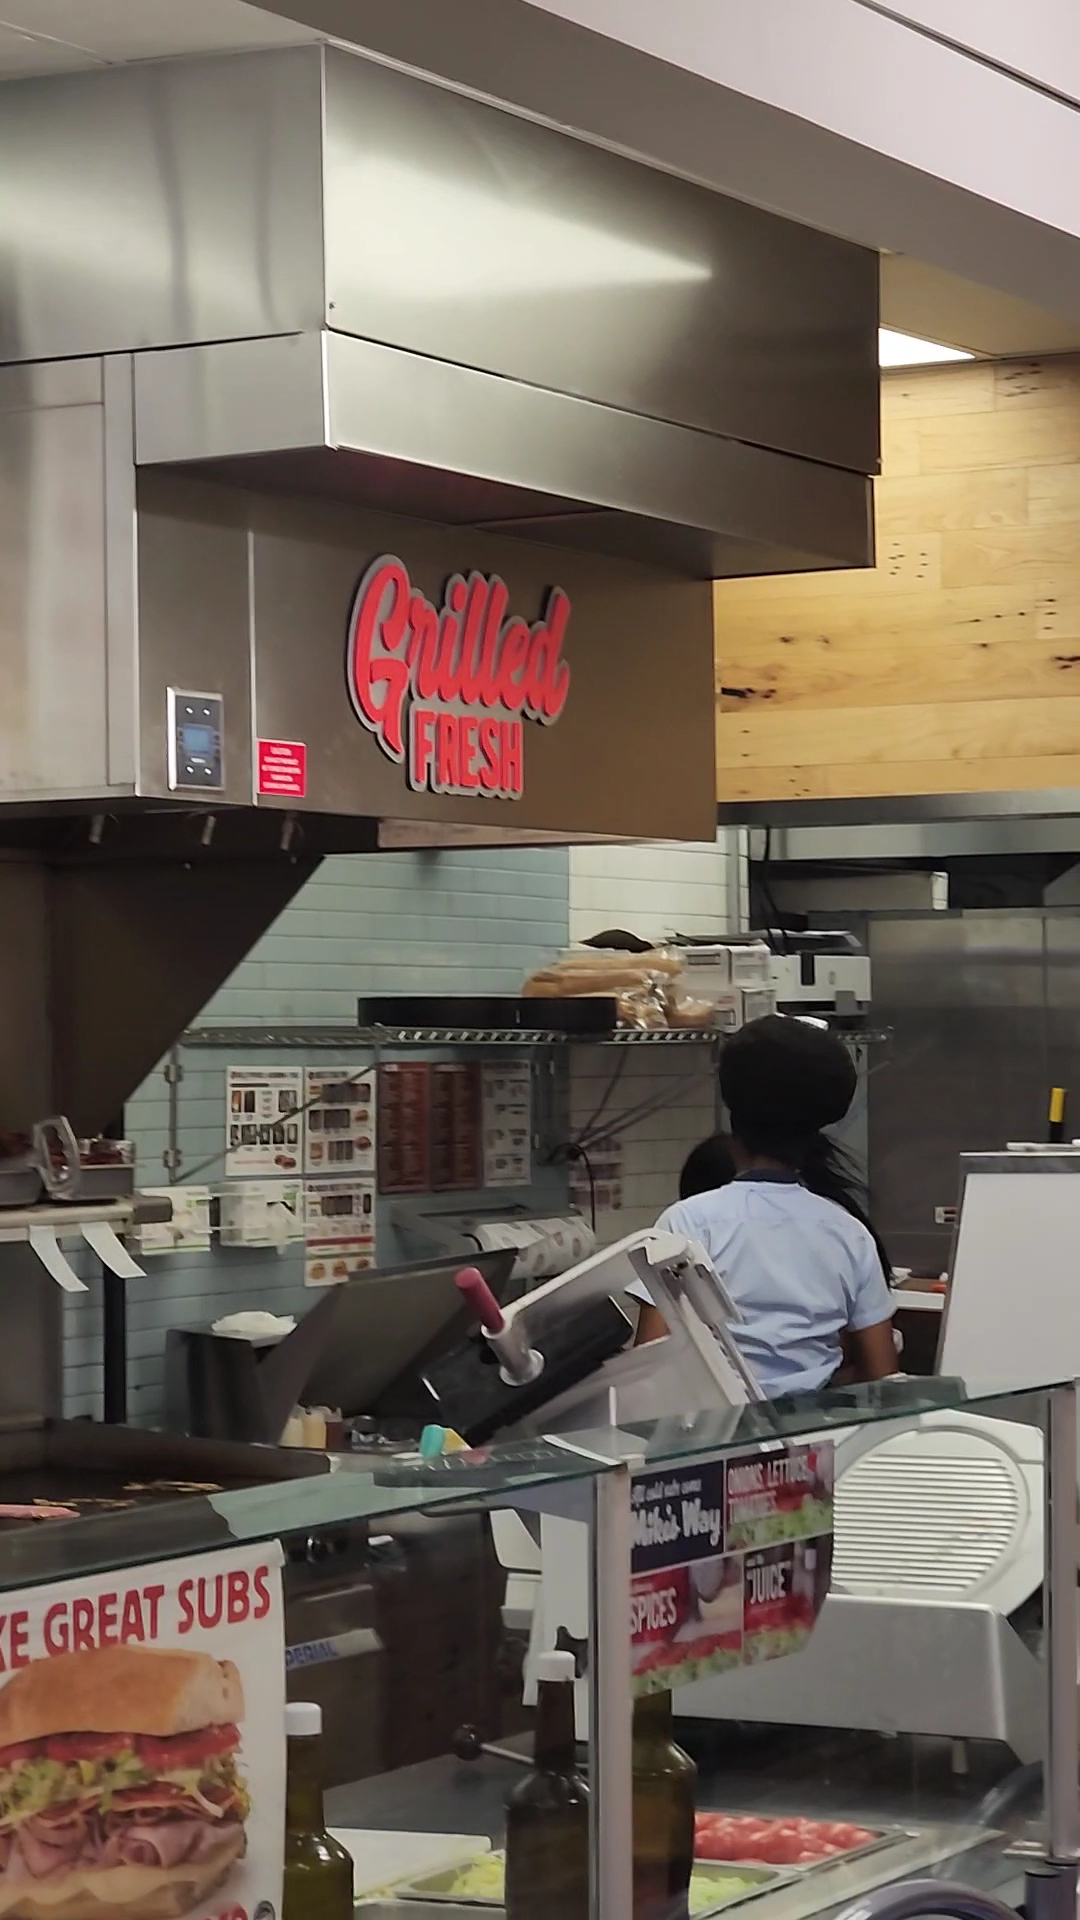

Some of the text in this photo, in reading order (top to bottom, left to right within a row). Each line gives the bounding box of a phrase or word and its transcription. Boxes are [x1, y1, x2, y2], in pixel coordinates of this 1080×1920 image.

[352, 563, 569, 754] Grilled
[415, 708, 522, 793] FRESH
[681, 1497, 721, 1546] Way
[43, 1584, 165, 1658] GREAT
[177, 1565, 271, 1634] SUBS
